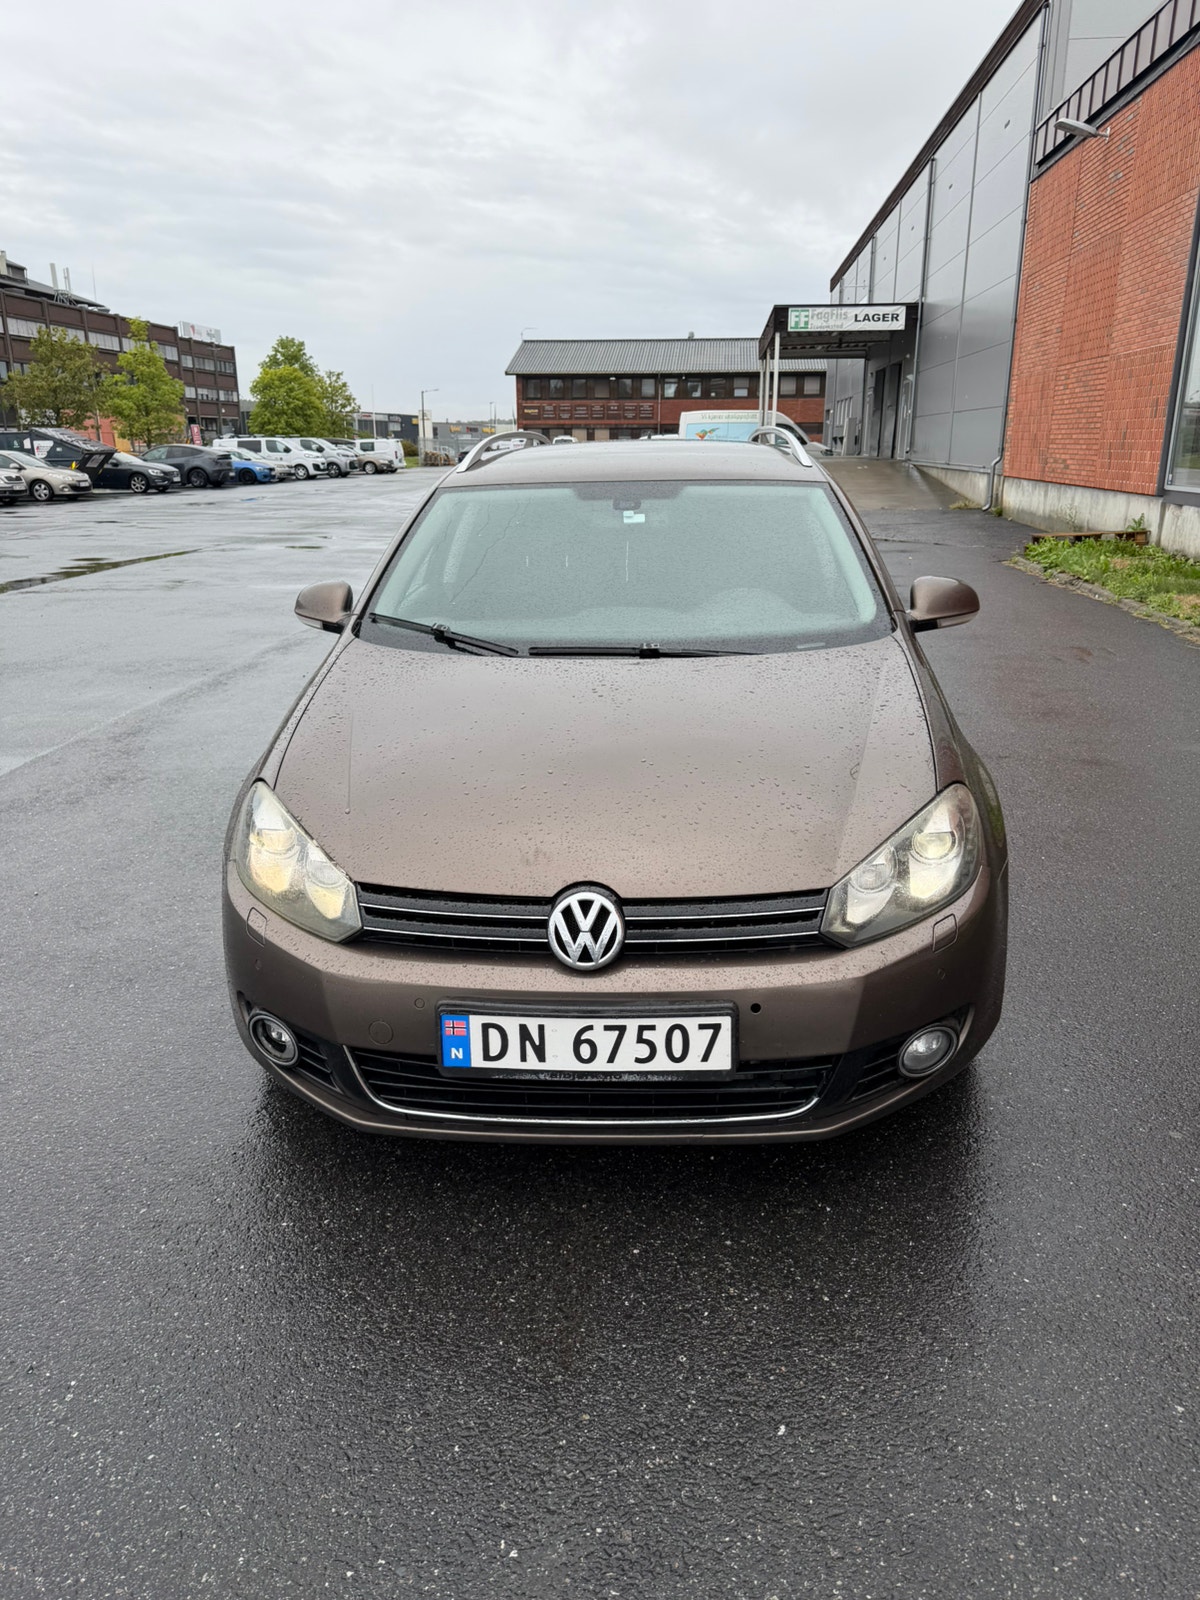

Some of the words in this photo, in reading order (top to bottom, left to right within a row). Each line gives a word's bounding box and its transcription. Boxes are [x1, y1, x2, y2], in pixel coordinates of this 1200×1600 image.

[811, 307, 848, 322] FagFlis
[854, 313, 900, 323] LAGER
[481, 1022, 546, 1062] DN
[572, 1023, 722, 1064] 67507
[451, 1047, 463, 1059] N
